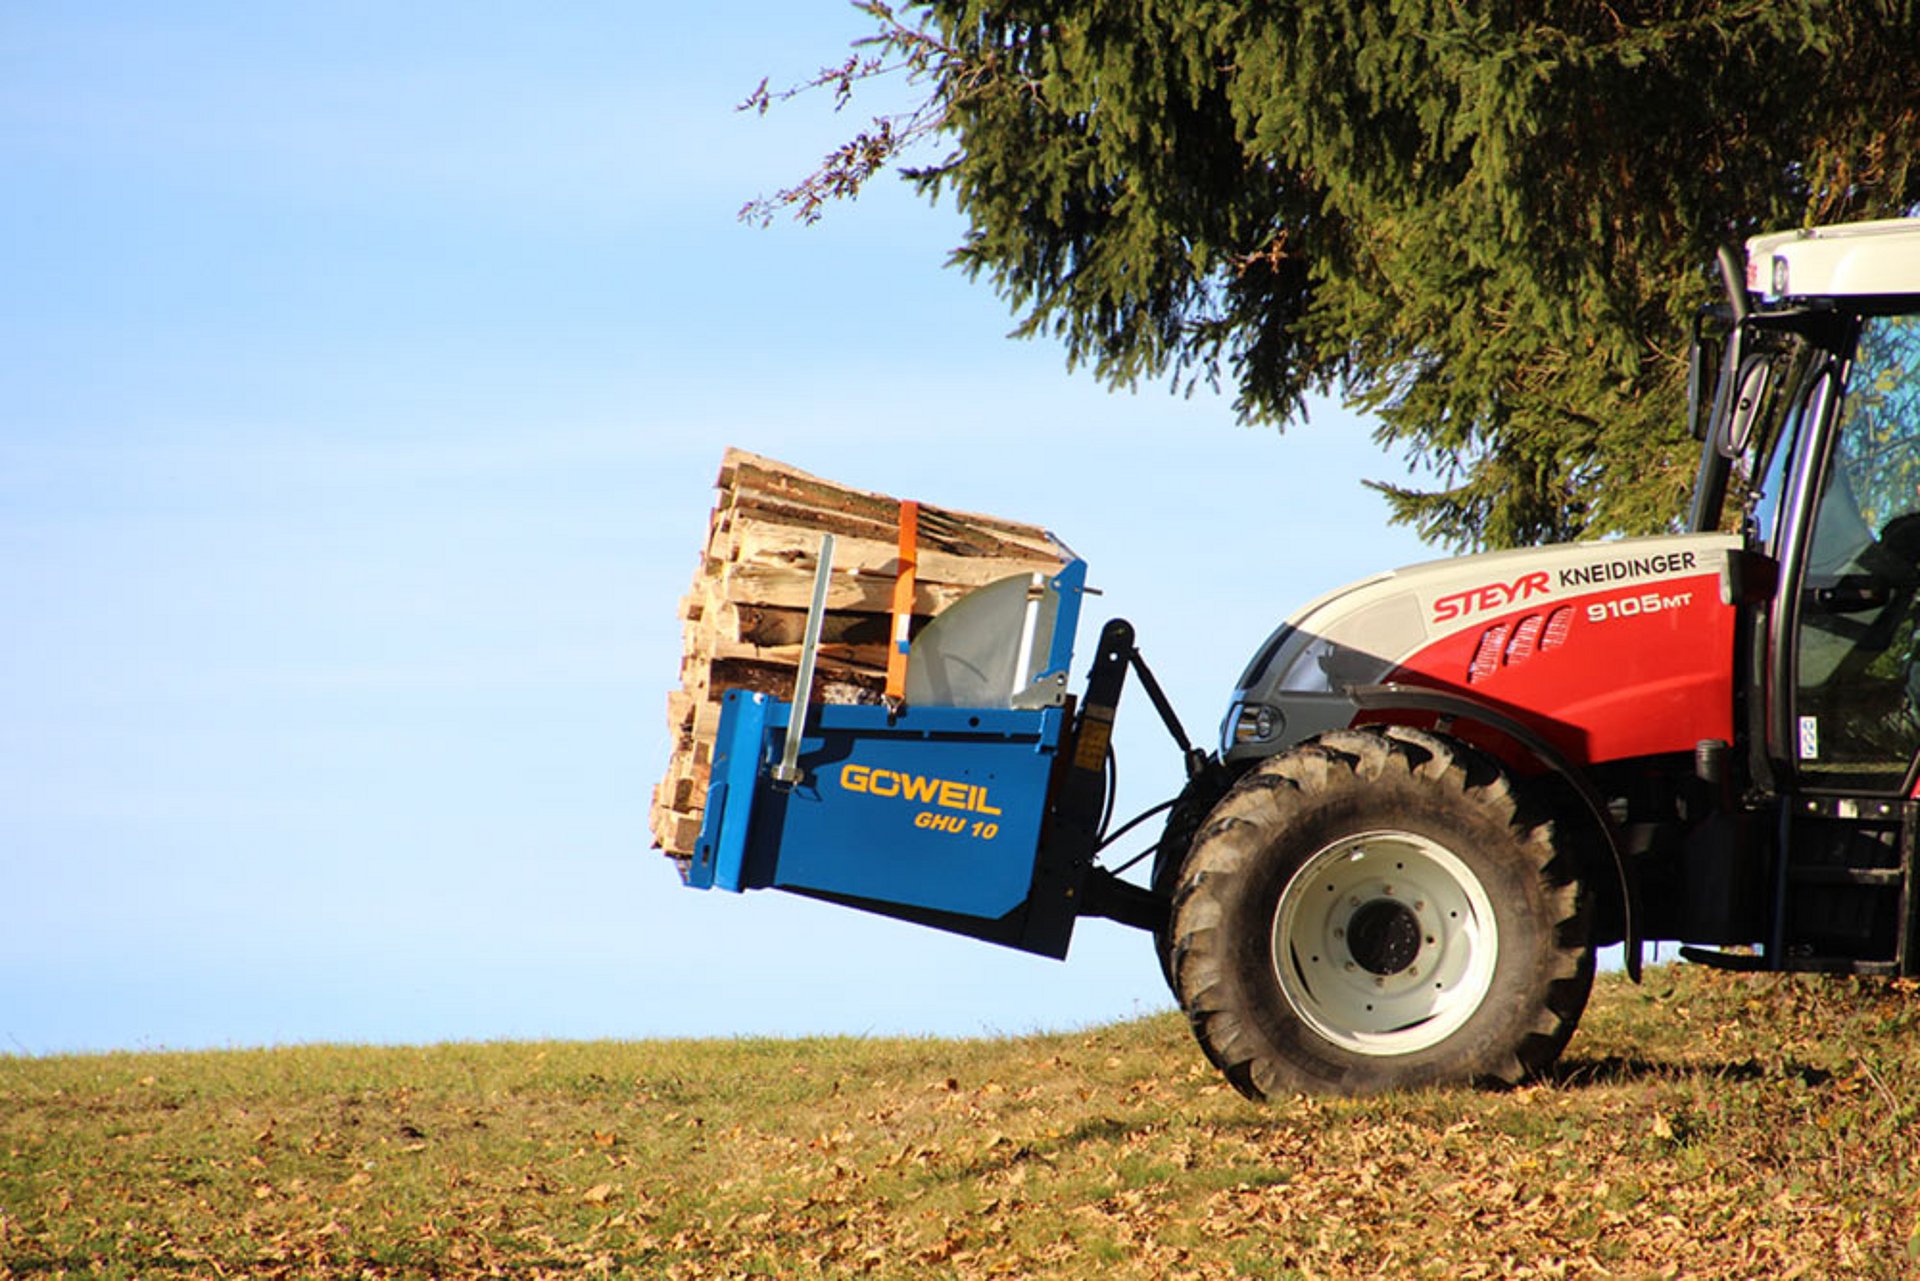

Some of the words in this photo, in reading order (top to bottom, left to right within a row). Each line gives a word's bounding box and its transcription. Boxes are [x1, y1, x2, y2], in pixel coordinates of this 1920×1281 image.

[1432, 570, 1550, 624] STEYR
[1559, 551, 1696, 587] KNEIDINGER
[914, 811, 966, 833] GHU
[971, 821, 999, 839] 10
